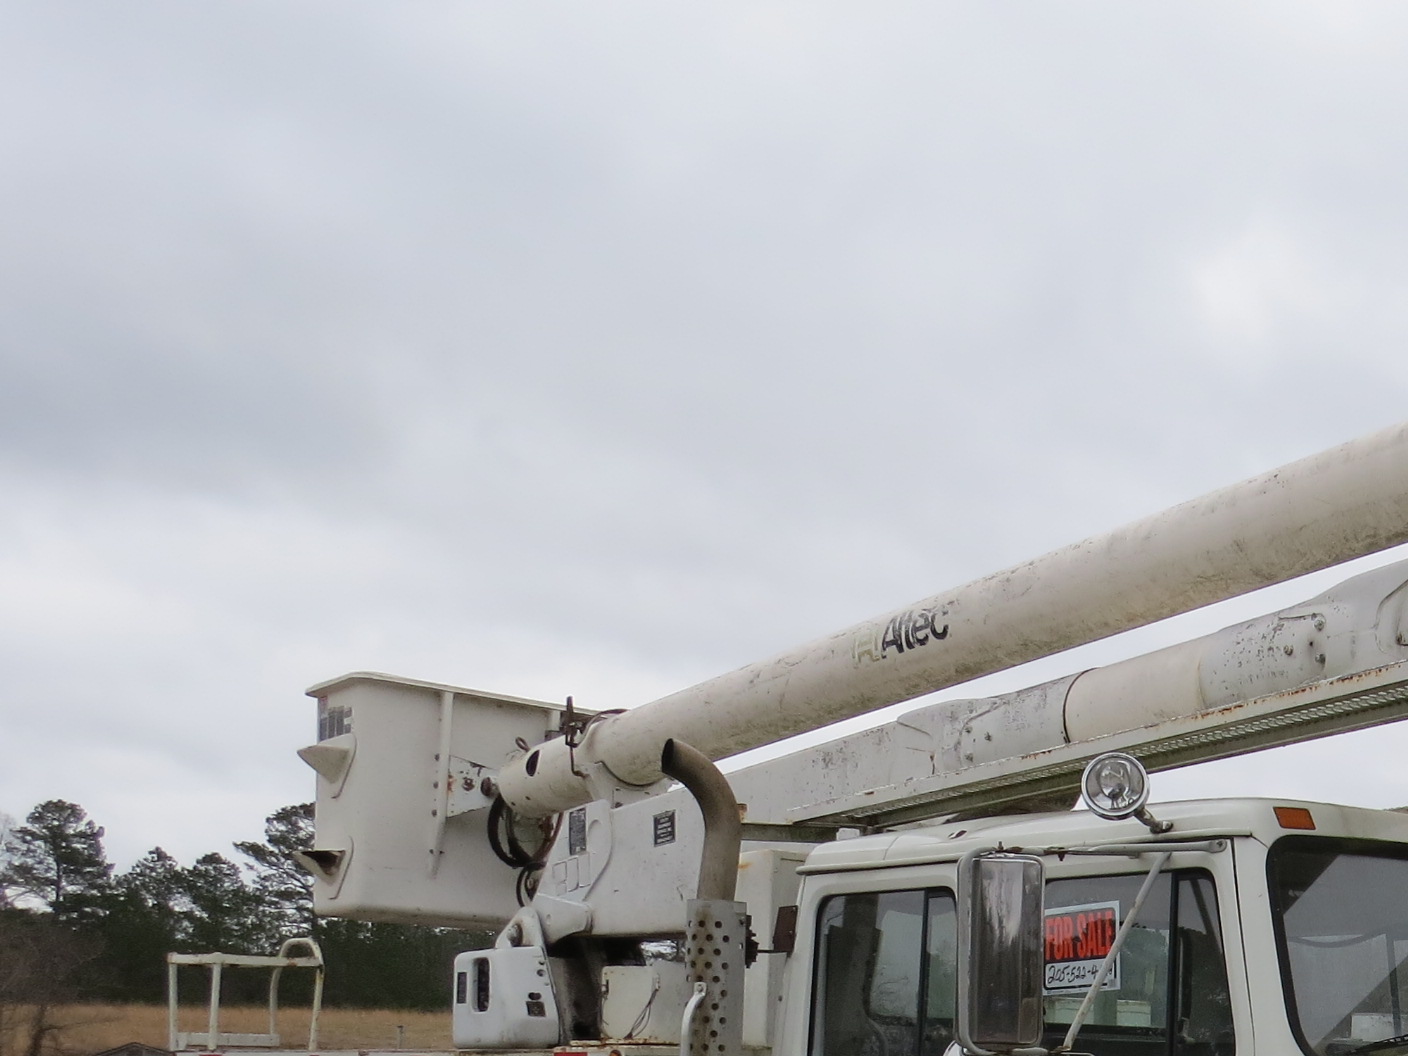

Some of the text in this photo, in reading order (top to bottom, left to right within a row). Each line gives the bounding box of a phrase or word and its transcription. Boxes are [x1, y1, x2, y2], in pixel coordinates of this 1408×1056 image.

[1045, 911, 1114, 960] FOR SALE
[1048, 964, 1113, 985] 205-522-4
